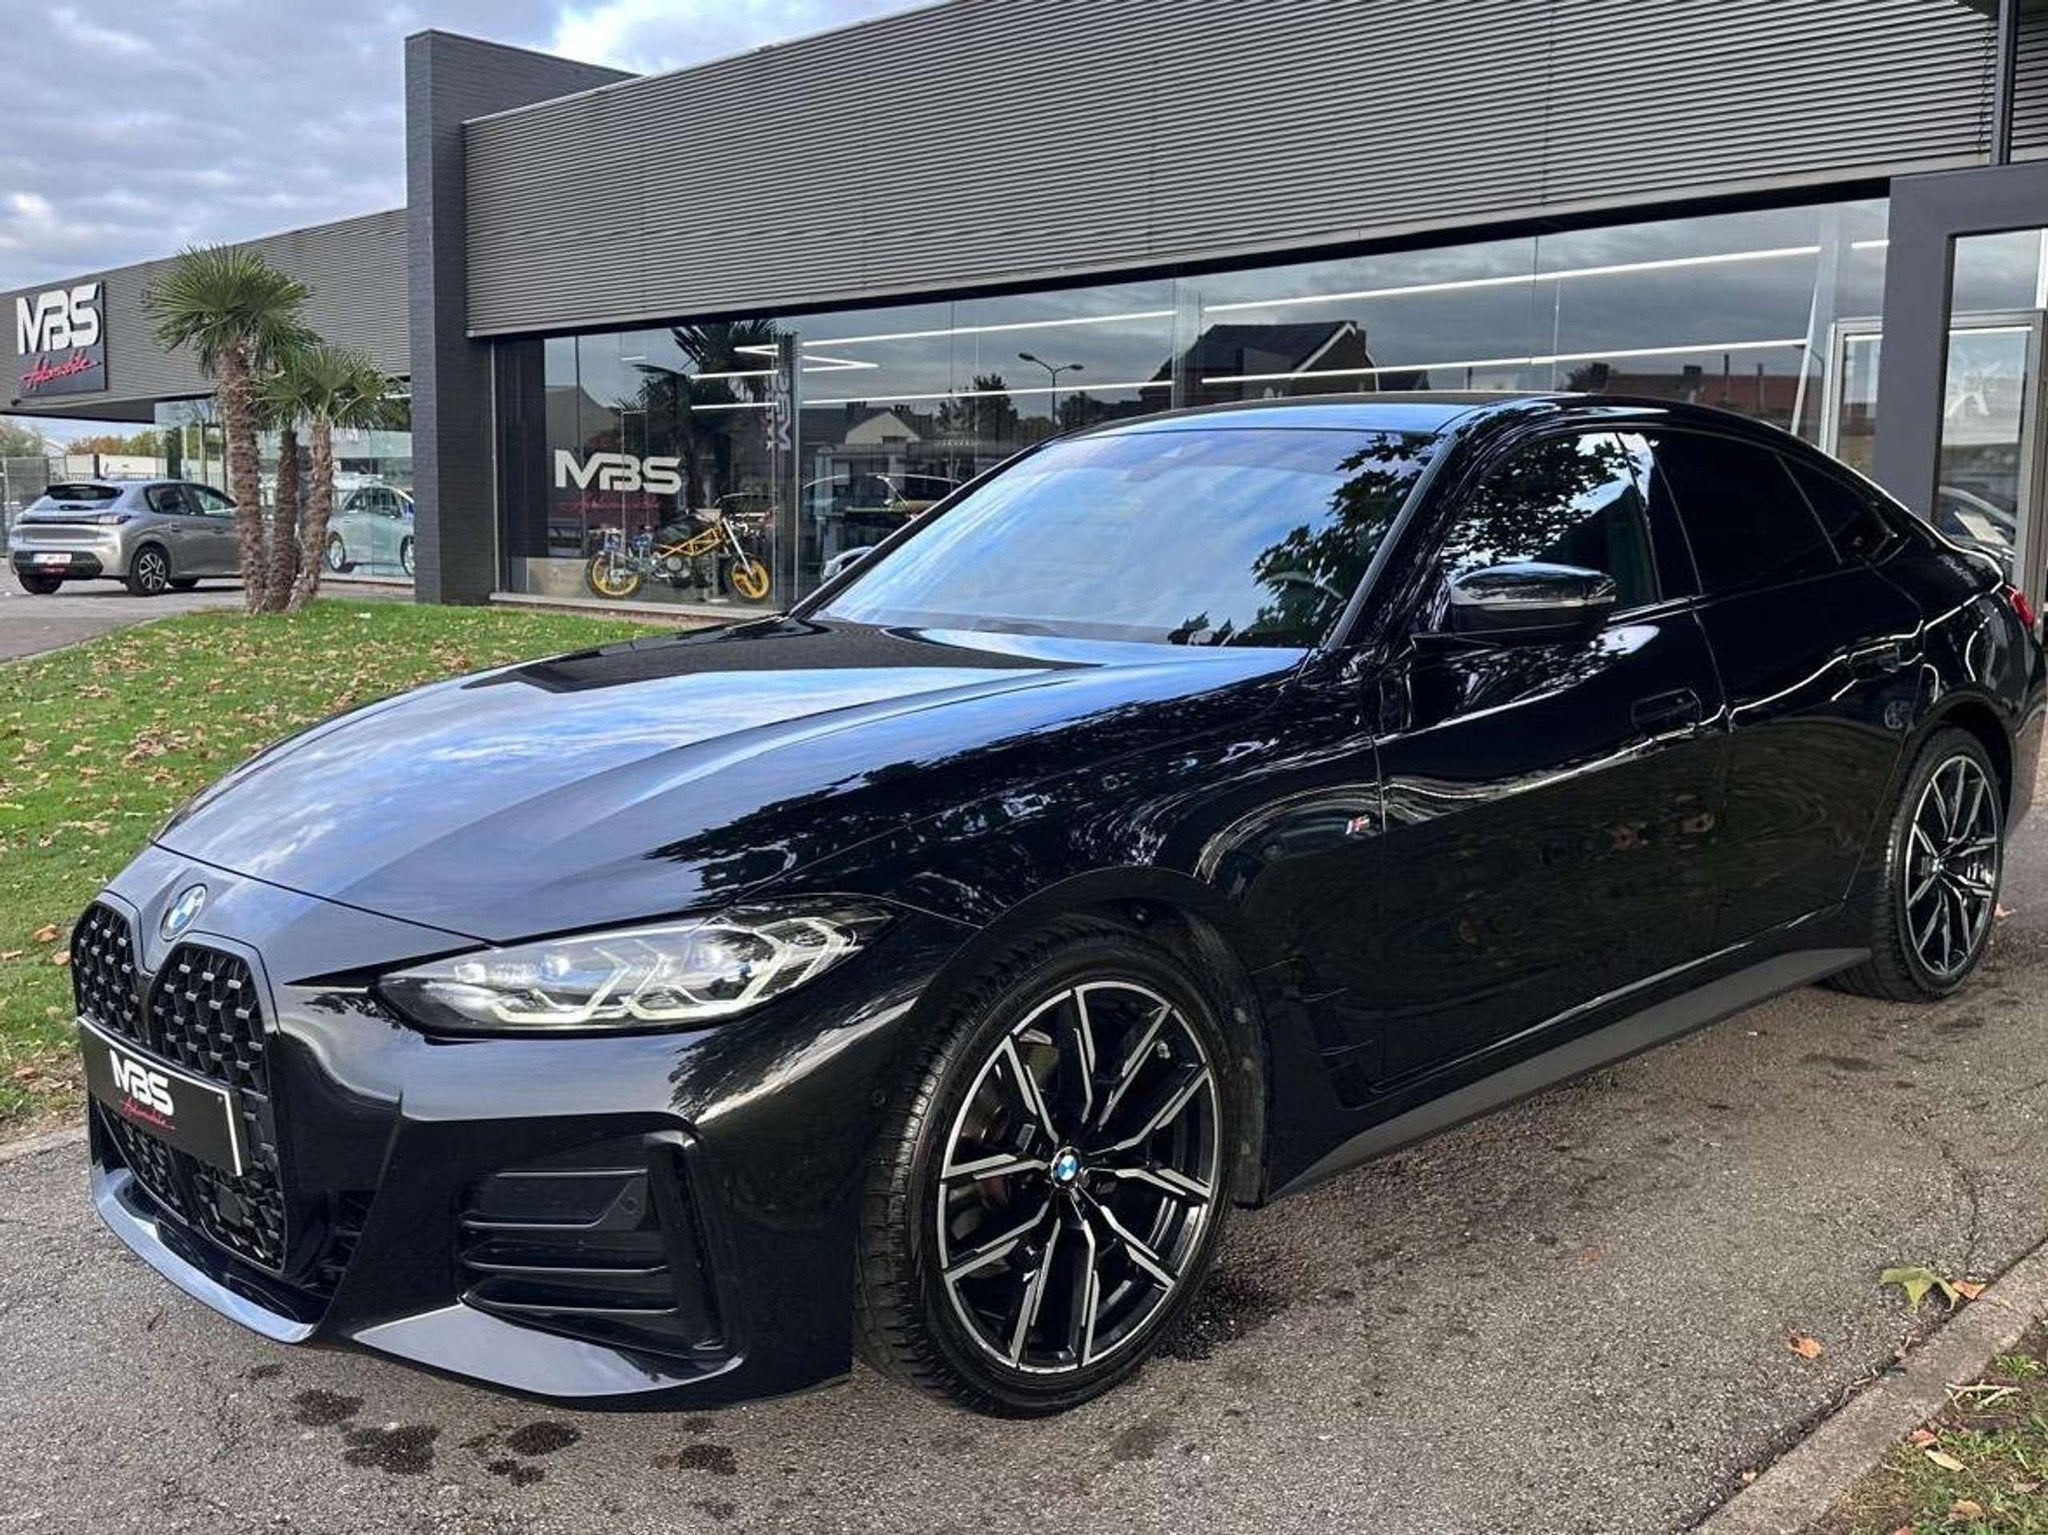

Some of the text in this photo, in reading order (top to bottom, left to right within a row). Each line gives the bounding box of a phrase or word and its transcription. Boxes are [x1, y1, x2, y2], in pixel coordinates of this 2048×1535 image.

[16, 283, 98, 355] MBS
[554, 449, 682, 494] MBS
[109, 1048, 174, 1116] MBS
